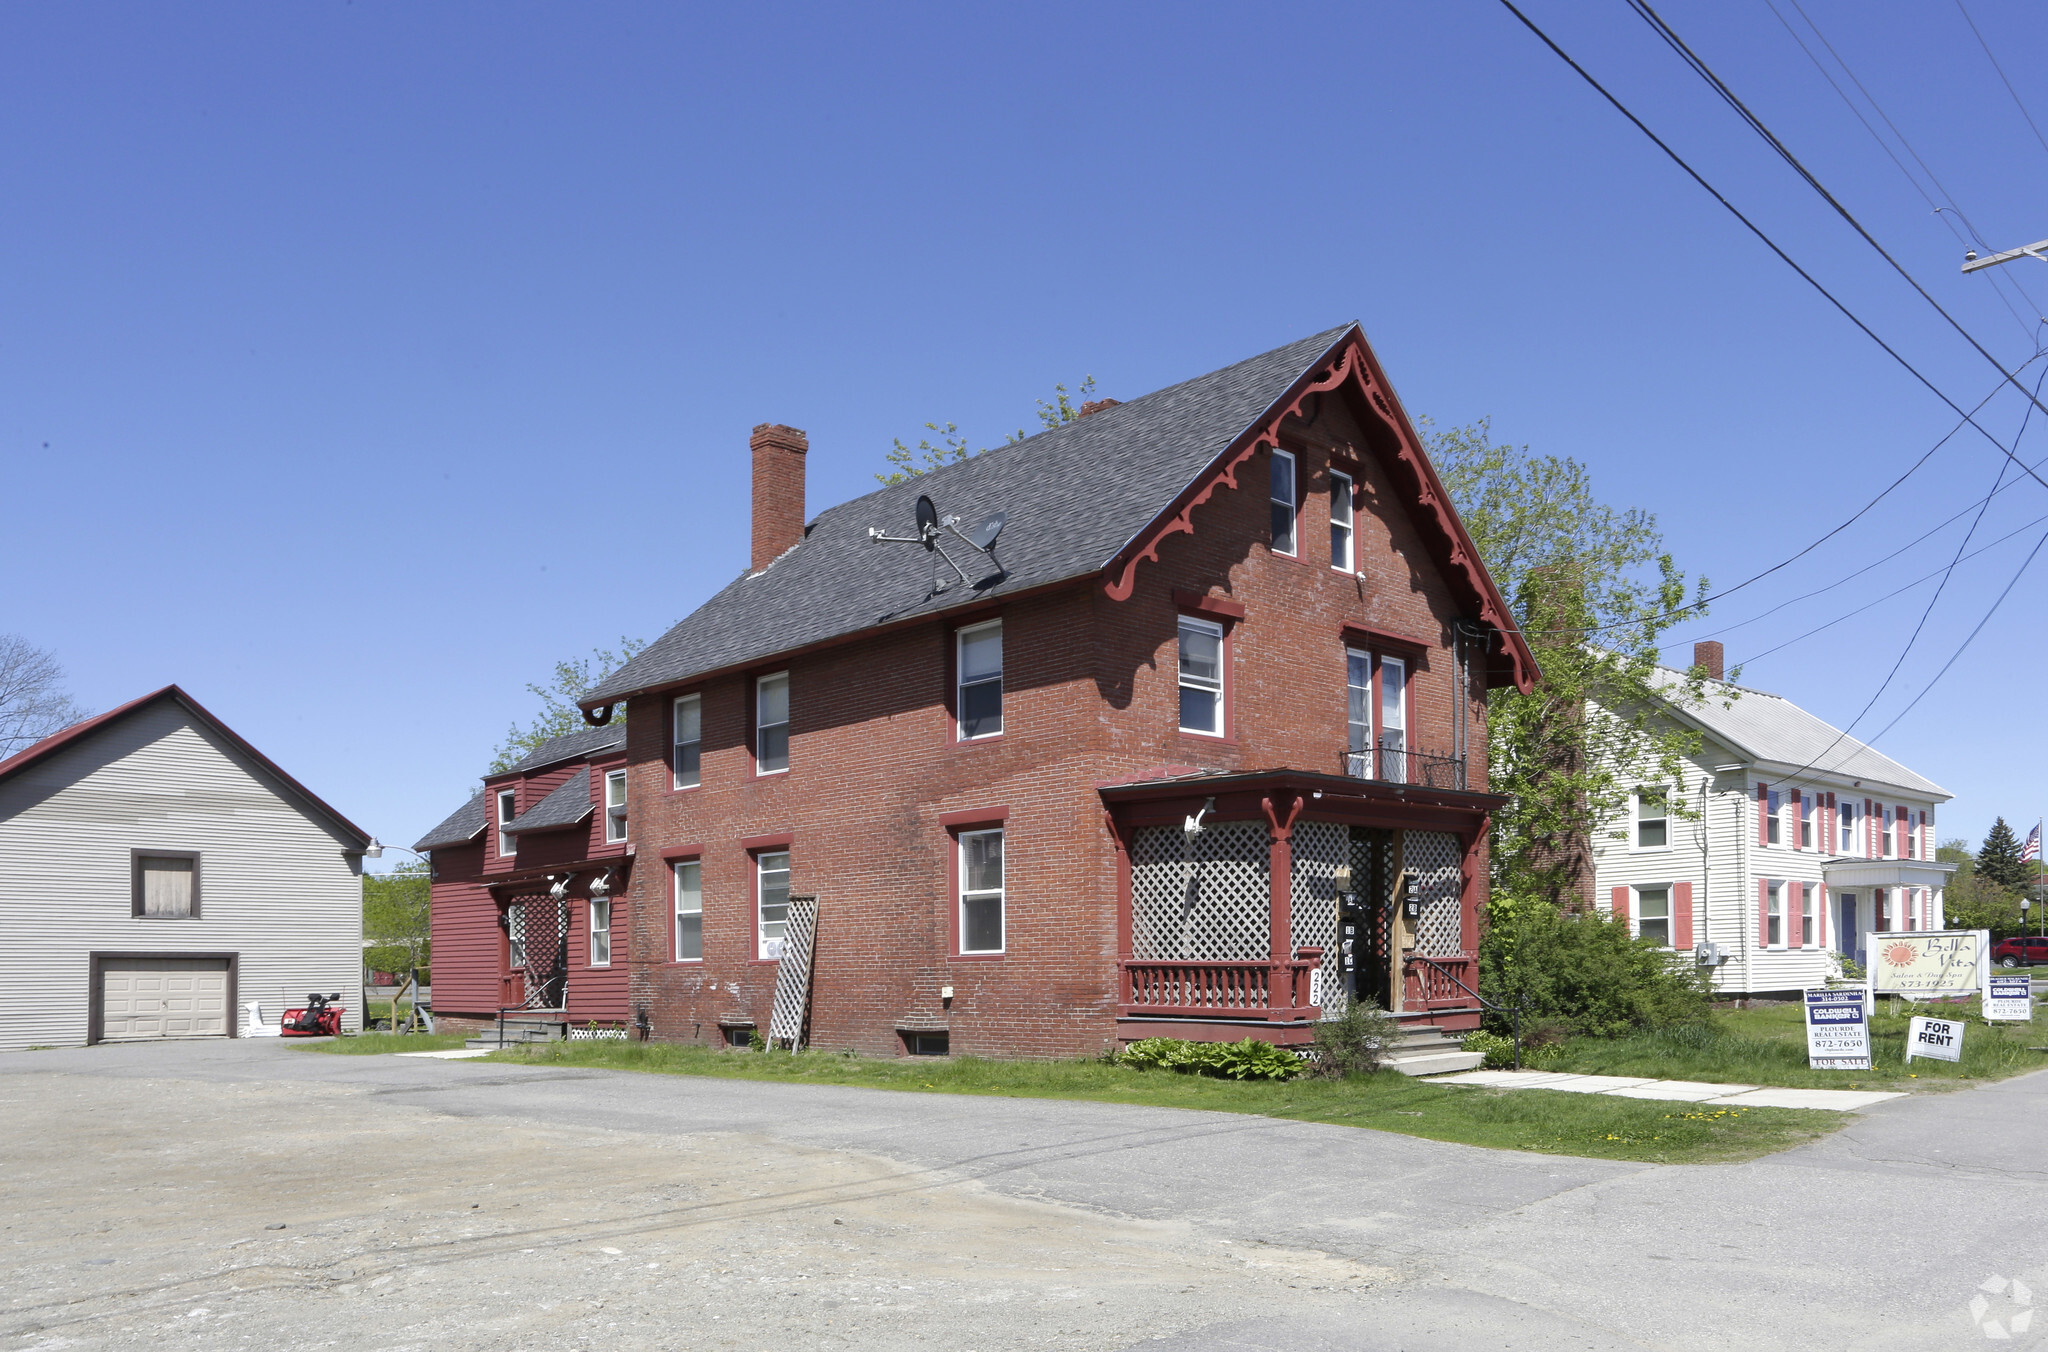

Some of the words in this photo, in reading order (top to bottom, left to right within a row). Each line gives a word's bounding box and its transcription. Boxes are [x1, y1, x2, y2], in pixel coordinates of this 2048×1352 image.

[1922, 938, 1971, 957] Bella
[1939, 953, 1975, 967] Vita
[1925, 971, 1944, 980] Day
[1946, 971, 1963, 979] Spa
[1900, 980, 1954, 988] 873-1925
[1925, 1021, 1950, 1034] FOR
[1815, 1040, 1862, 1048] 872-7650
[1918, 1032, 1953, 1046] RENT
